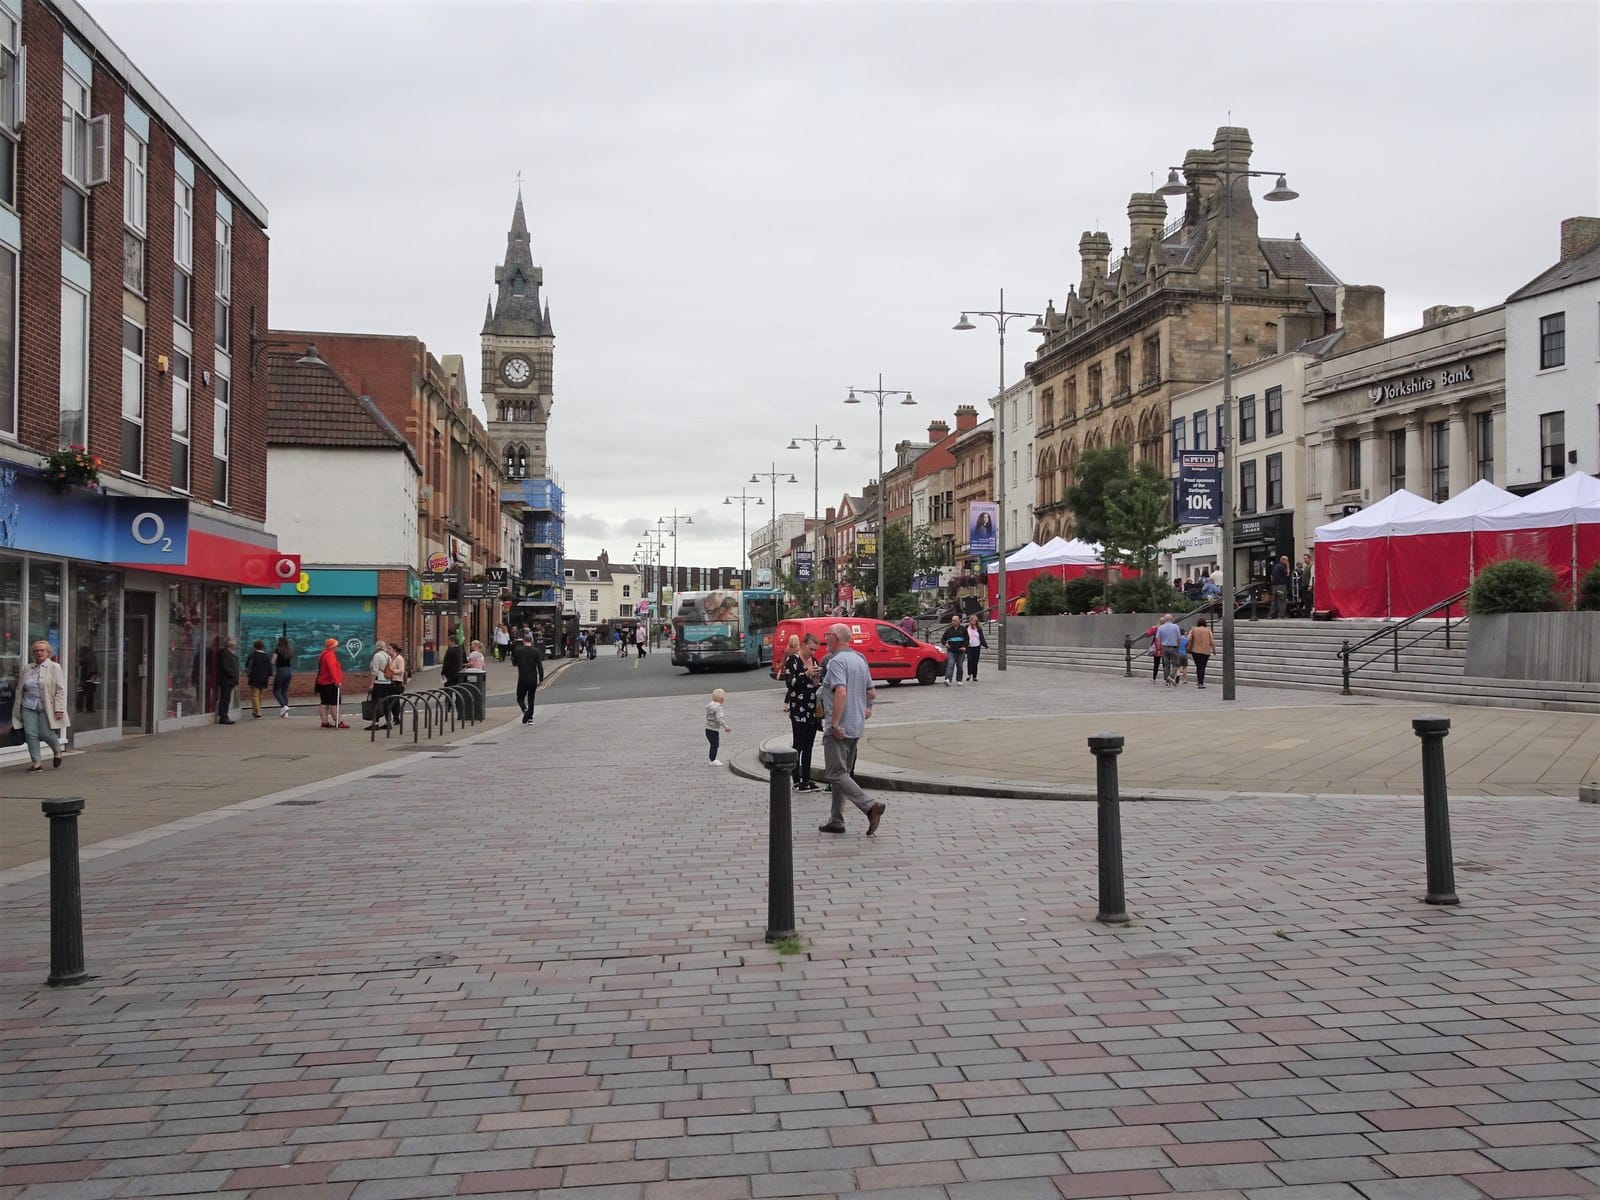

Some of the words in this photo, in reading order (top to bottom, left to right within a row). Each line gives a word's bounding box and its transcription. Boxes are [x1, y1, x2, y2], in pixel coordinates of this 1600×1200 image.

[1384, 378, 1433, 399] Yorkshire
[1440, 365, 1472, 385] Bank
[1186, 495, 1213, 510] 10k
[1177, 537, 1194, 547] Optical
[1194, 536, 1214, 548] Express
[430, 561, 449, 570] KING
[491, 571, 504, 581] W
[798, 569, 810, 577] 10k
